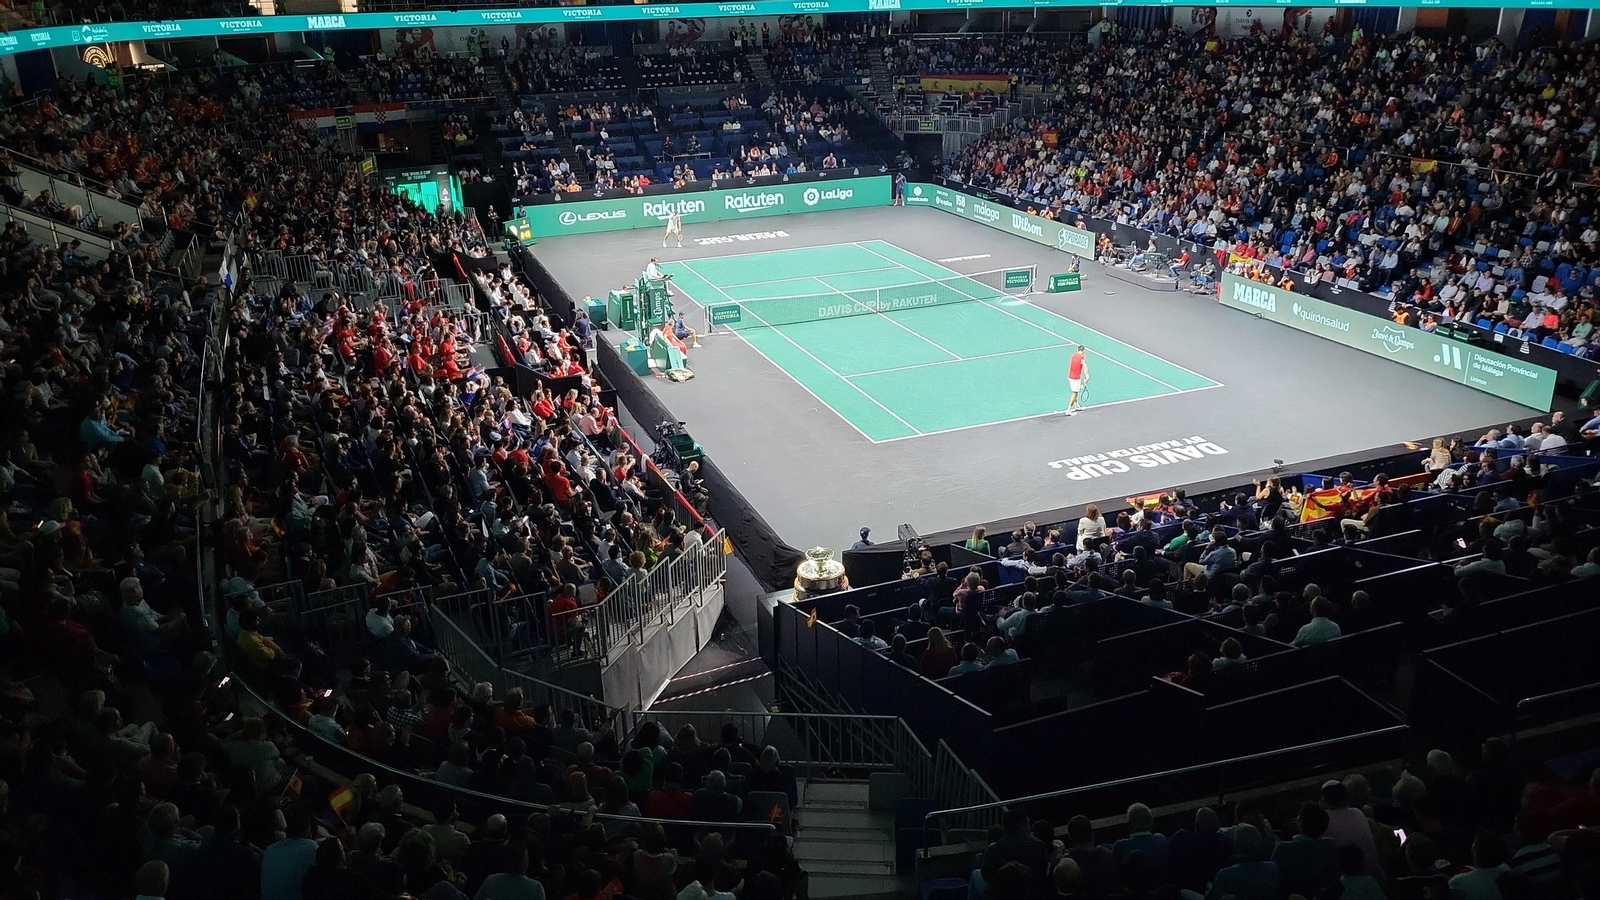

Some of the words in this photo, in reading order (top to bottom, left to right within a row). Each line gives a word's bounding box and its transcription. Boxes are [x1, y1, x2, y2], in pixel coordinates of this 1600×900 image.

[641, 6, 680, 14] VICTORIA
[718, 4, 756, 12] VICTORIA
[793, 1, 830, 9] VICTORIA
[394, 14, 437, 22] VICTORIA
[480, 11, 522, 19] VICTORIA
[562, 9, 602, 17] VICTORIA
[142, 23, 182, 33] VICTORIA
[219, 20, 263, 29] VICTORIA
[307, 15, 346, 29] MARCA
[821, 188, 853, 200] LaLiga
[725, 192, 784, 210] Rakuten
[643, 199, 705, 217] Rakuten
[973, 201, 1000, 222] málaga
[578, 210, 627, 220] LEXUS
[1012, 213, 1043, 237] Wilson
[1233, 281, 1276, 313] MARCA
[818, 303, 852, 318] DAVIS
[854, 300, 877, 313] CUP
[880, 300, 891, 310] by
[892, 294, 938, 308] RAKUTEN
[713, 313, 740, 321] VICTORIA
[1474, 353, 1507, 369] Diputación
[1507, 363, 1538, 379] Provincial
[1481, 364, 1504, 377] Málaga
[1183, 435, 1208, 445] BY
[1106, 439, 1185, 458] RAKUTEN
[1129, 441, 1230, 468] DAVIS
[1047, 451, 1107, 469] FINALS
[1066, 459, 1131, 481] CUP
